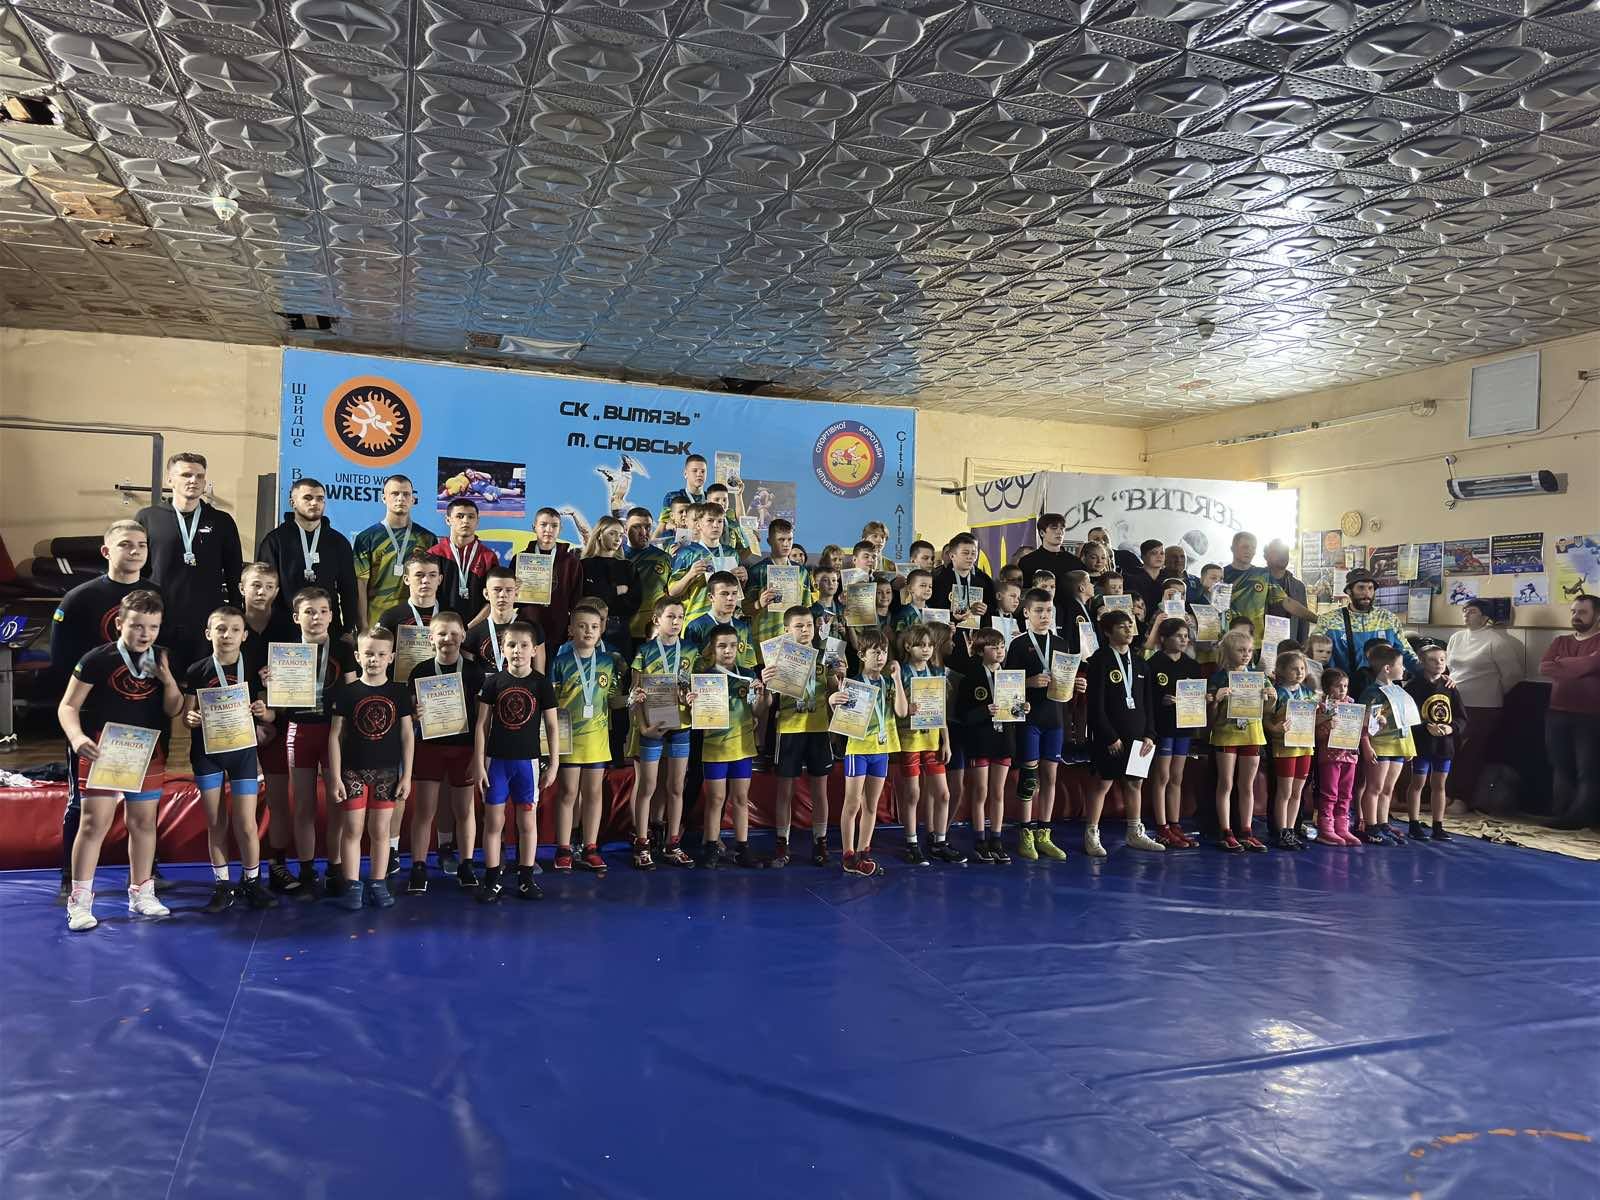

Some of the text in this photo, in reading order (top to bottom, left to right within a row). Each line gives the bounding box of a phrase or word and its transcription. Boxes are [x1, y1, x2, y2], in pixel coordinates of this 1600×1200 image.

[559, 401, 590, 417] СК
[593, 434, 693, 456] СНОВСЬК
[335, 472, 371, 485] UNITED
[1064, 495, 1105, 532] СК
